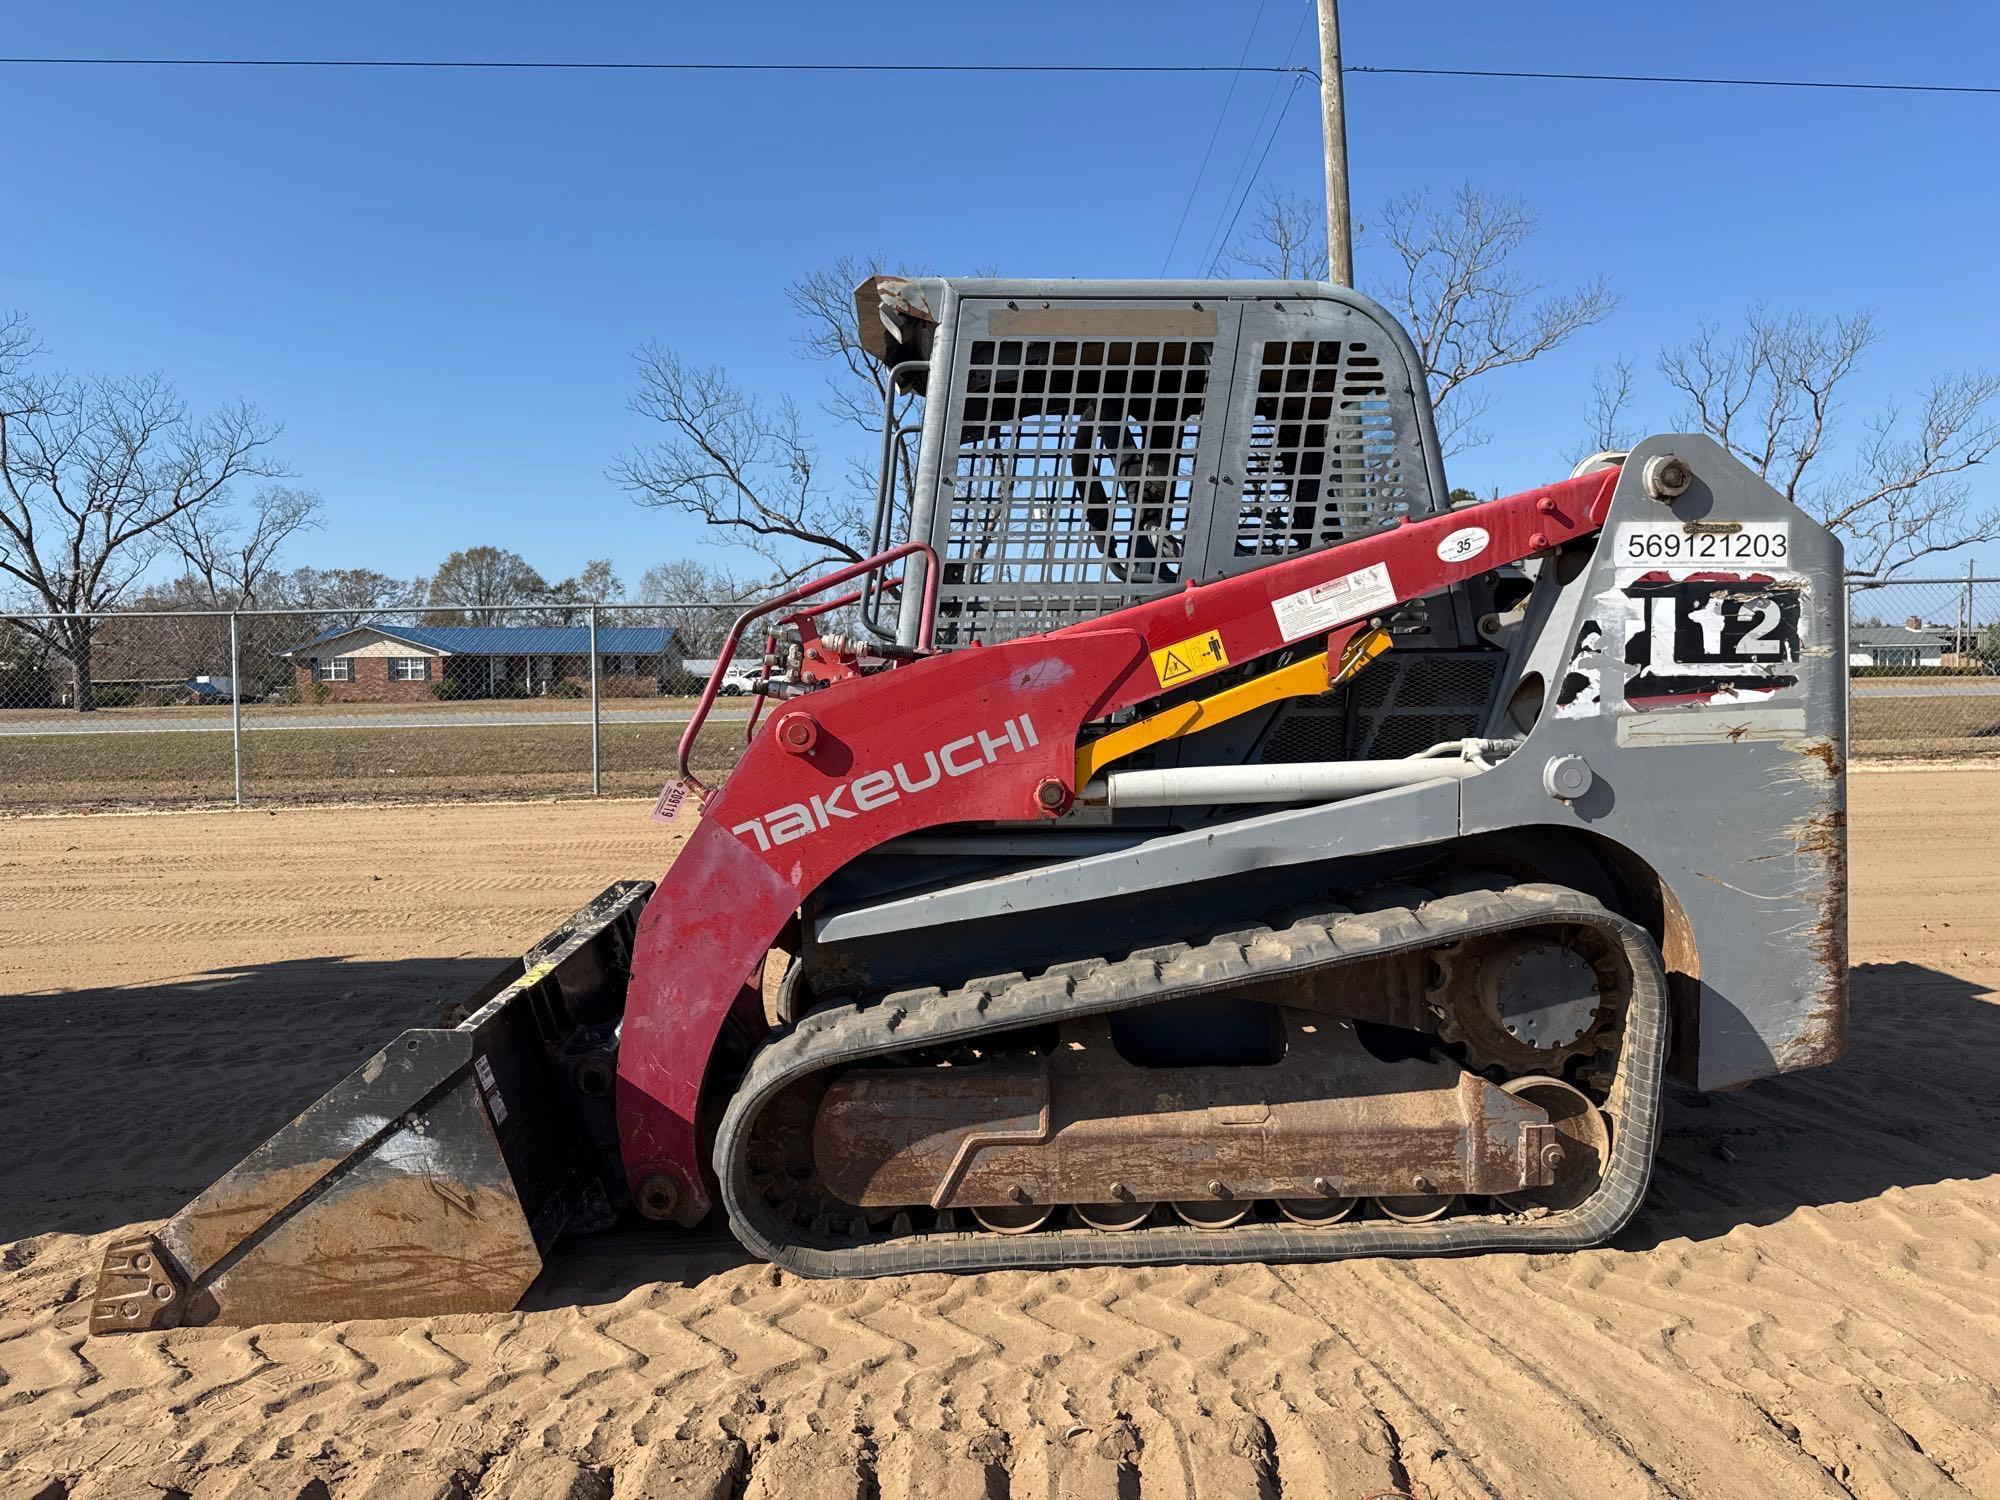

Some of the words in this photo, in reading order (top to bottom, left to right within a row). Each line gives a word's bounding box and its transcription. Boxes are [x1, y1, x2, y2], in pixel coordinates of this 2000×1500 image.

[1456, 538, 1471, 554] 35
[1628, 534, 1787, 558] 569121203
[661, 788, 685, 818] 209119
